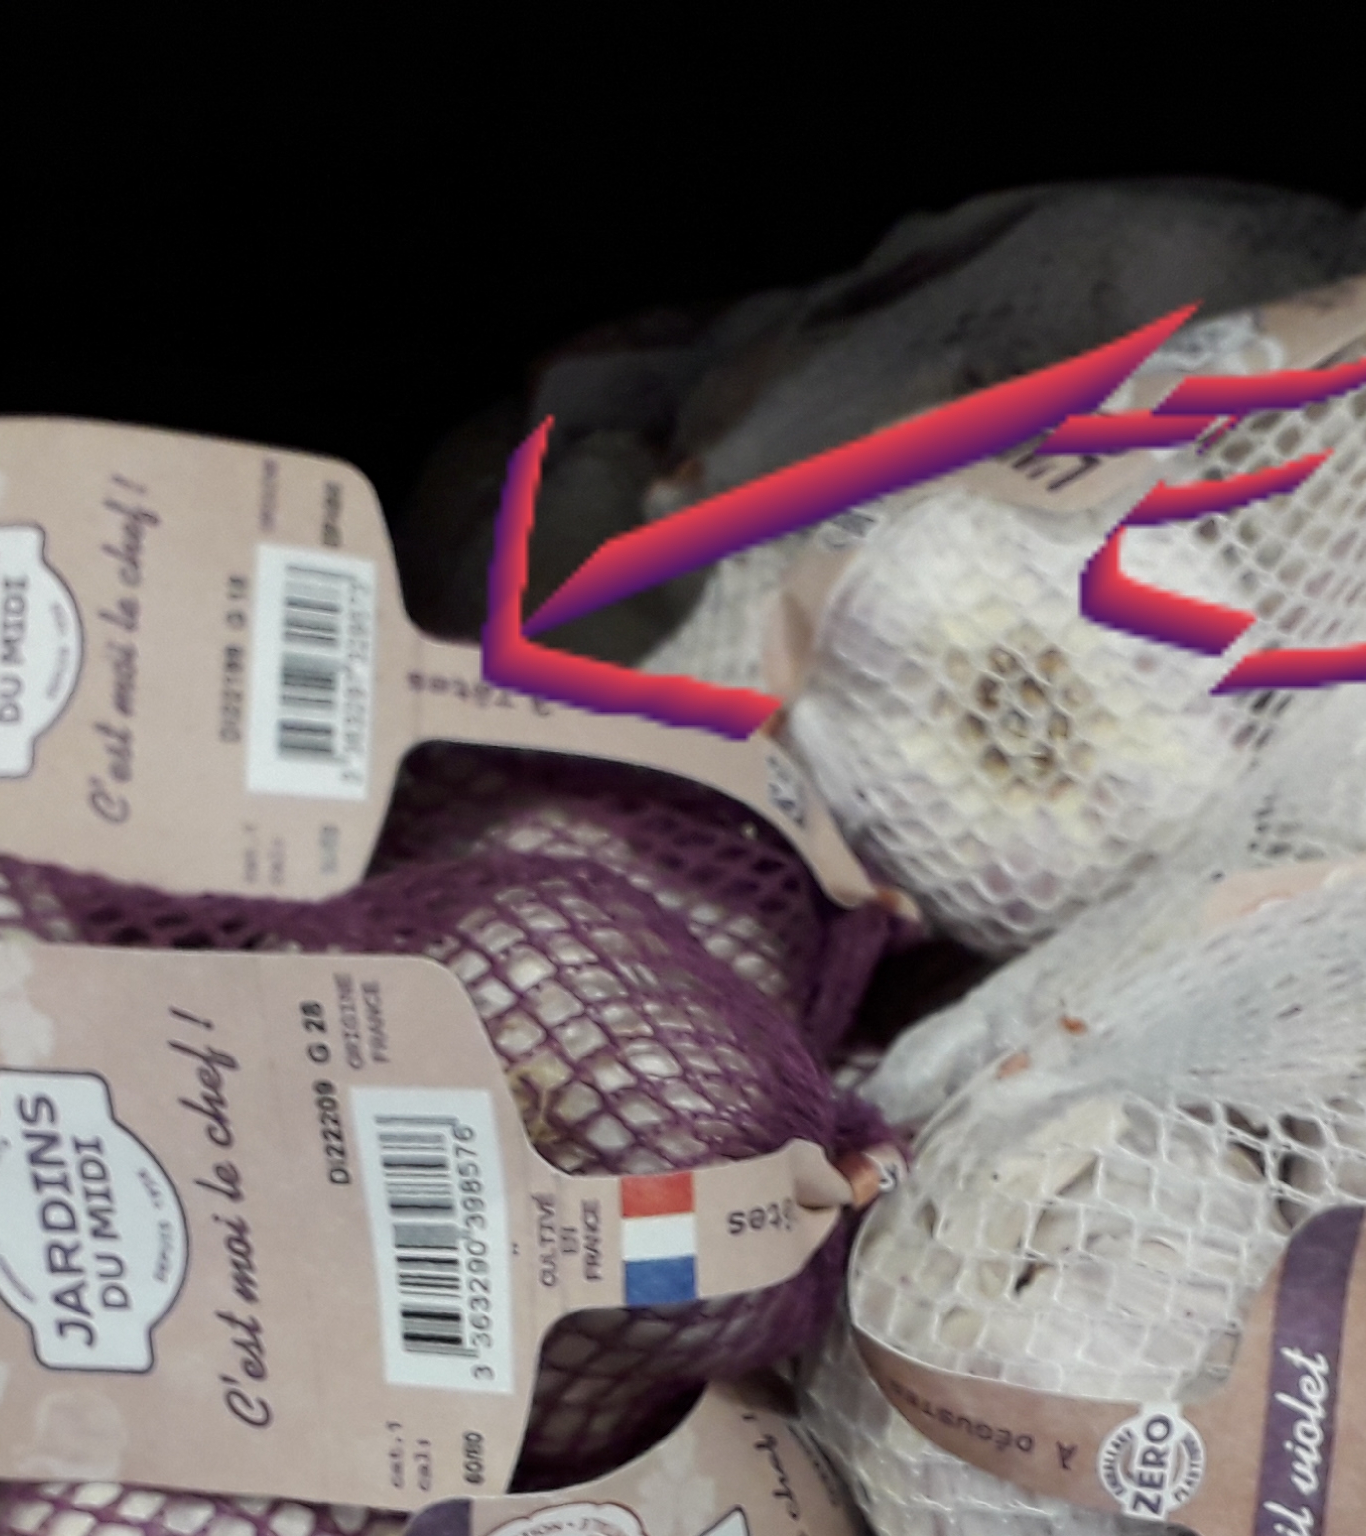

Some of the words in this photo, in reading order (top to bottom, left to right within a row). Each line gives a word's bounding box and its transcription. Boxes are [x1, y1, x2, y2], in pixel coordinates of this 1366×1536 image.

[0, 575, 30, 665] MIDI
[168, 1006, 215, 1030] !
[167, 1040, 241, 1149] chef
[16, 1094, 96, 1348] JARDINS
[72, 1135, 120, 1241] MIDI
[194, 1162, 245, 1203] le
[100, 1254, 133, 1311] DU
[211, 1213, 260, 1304] moi
[216, 1309, 273, 1430] C'est
[1273, 1346, 1330, 1497] violet
